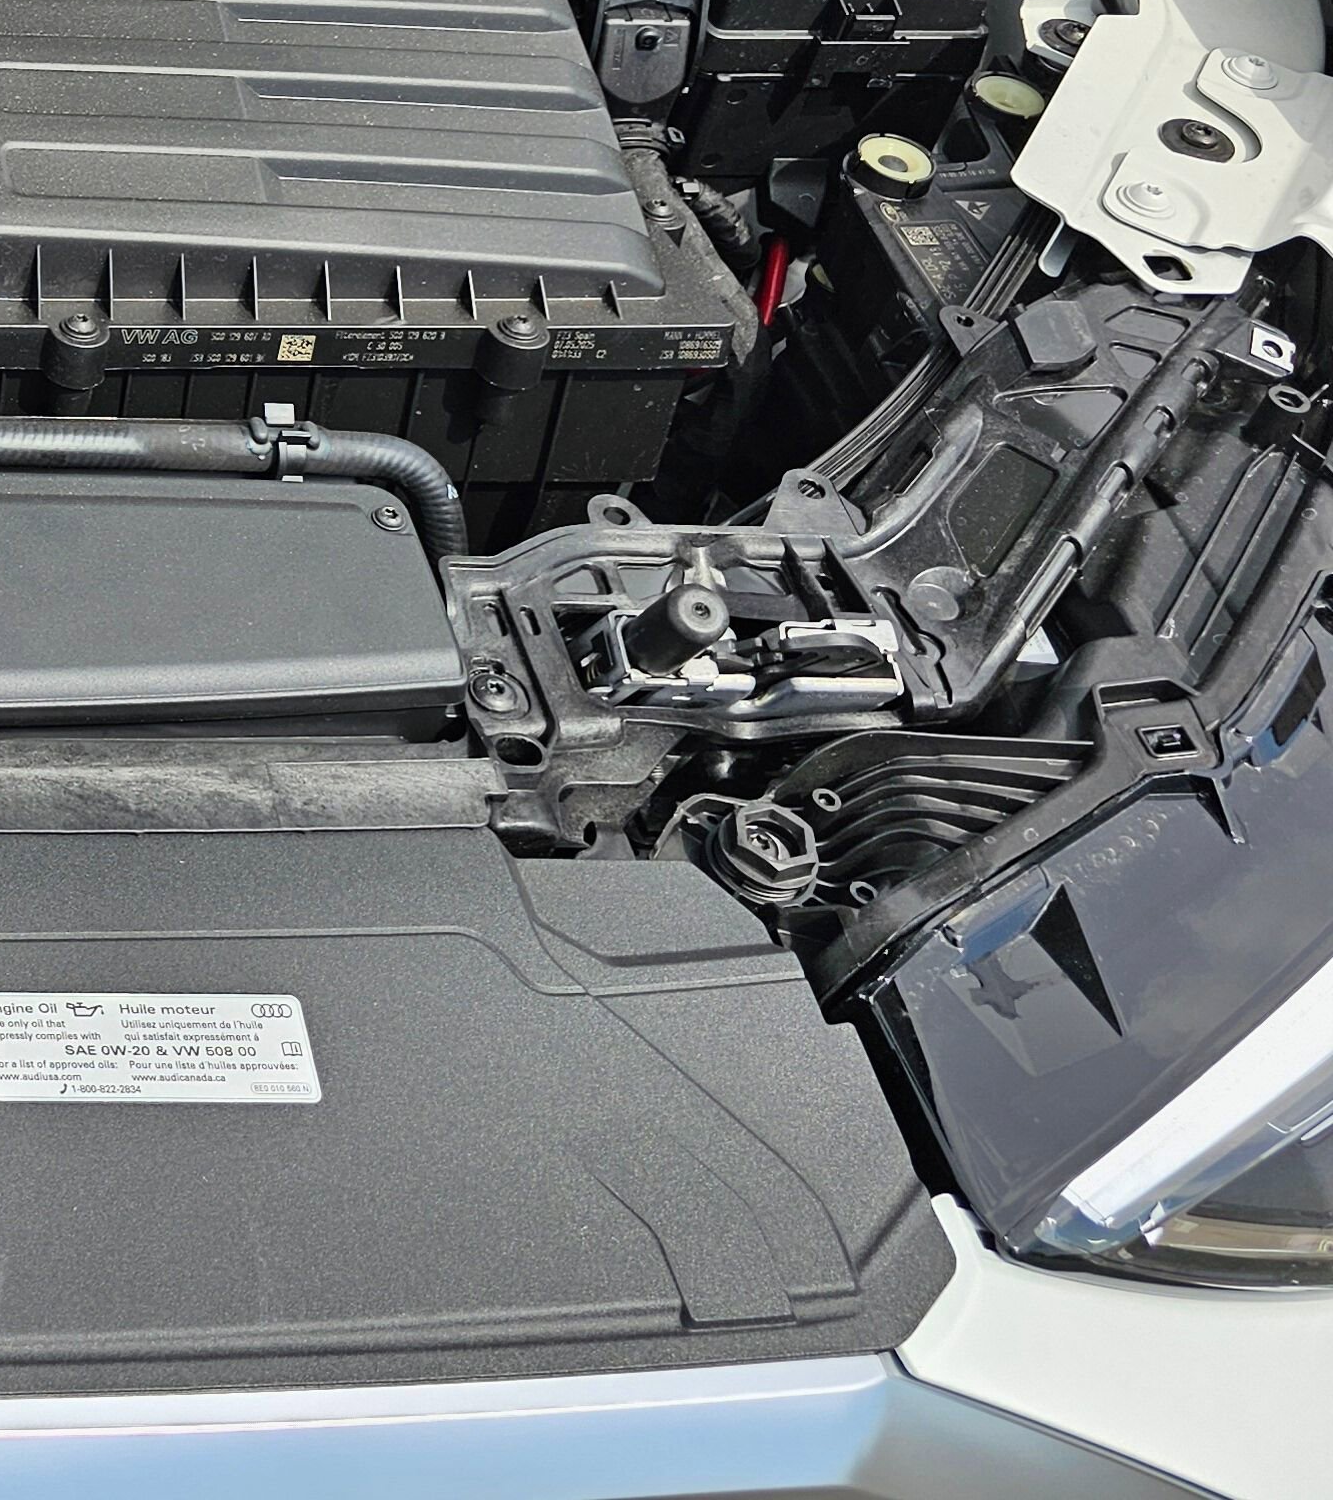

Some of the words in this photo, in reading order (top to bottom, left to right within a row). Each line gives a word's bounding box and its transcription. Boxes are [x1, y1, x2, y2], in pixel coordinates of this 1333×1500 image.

[121, 329, 160, 344] VW
[162, 329, 198, 344] AG
[38, 1003, 57, 1013] Oil
[119, 1005, 155, 1014] Huile
[161, 1005, 215, 1015] moteur
[8, 1020, 28, 1029] only
[121, 1020, 156, 1029] Utilisez
[159, 1021, 216, 1031] uniquement
[219, 1021, 231, 1029] de
[36, 1032, 78, 1041] complies
[124, 1034, 140, 1042] qui
[143, 1033, 181, 1041] satisfait
[183, 1033, 250, 1042] expressément
[65, 1045, 97, 1055] SAE
[101, 1046, 150, 1056] 0W-20
[156, 1046, 167, 1056] &
[173, 1046, 200, 1056] VW
[206, 1046, 233, 1056] 508
[238, 1047, 256, 1057] 00
[20, 1060, 33, 1068] list
[37, 1060, 46, 1068] of
[49, 1060, 95, 1070] approved
[98, 1060, 118, 1068] oils:
[129, 1061, 151, 1069] Pour
[176, 1061, 195, 1069] liste
[240, 1061, 298, 1071] approuvées:
[131, 1073, 225, 1082] www.audicanada.ca
[72, 1085, 141, 1093] 1-800-822-2834
